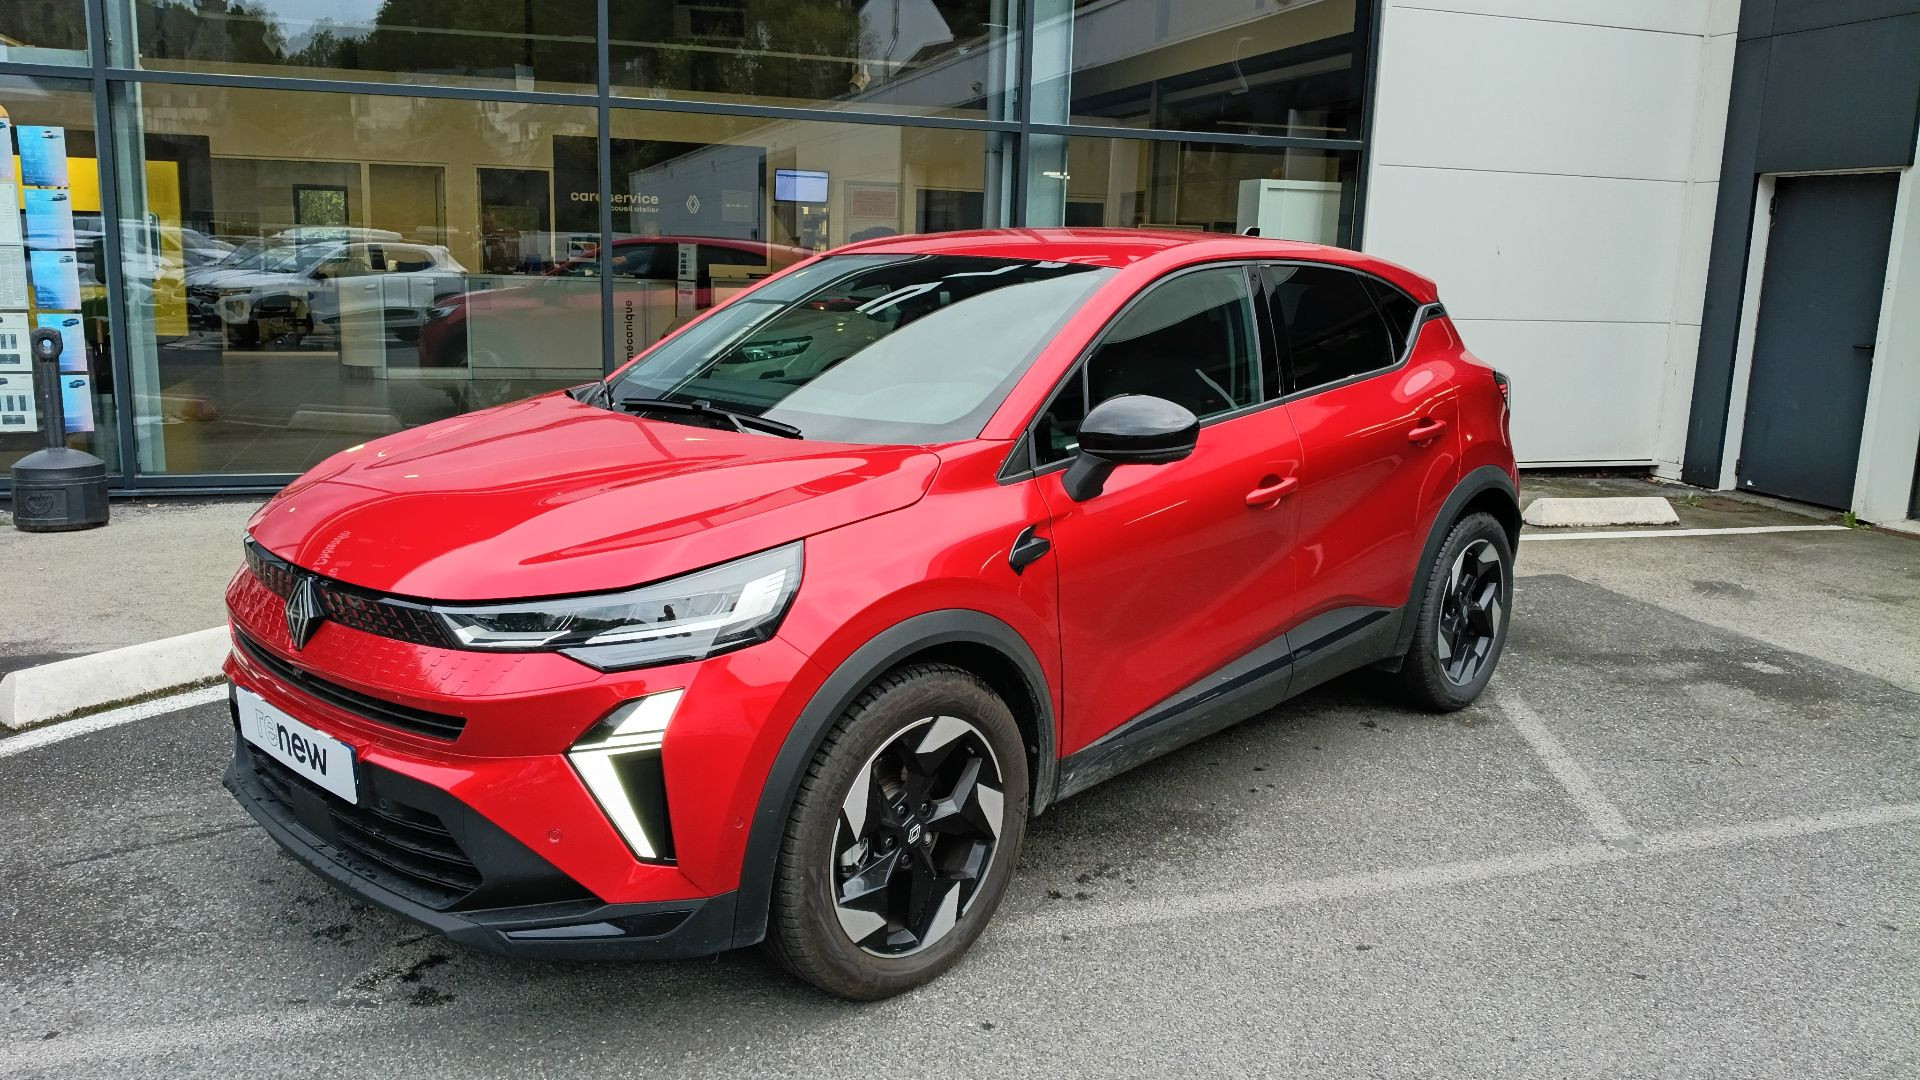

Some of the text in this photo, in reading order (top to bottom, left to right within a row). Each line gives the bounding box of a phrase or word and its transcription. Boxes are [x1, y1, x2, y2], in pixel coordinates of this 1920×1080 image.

[610, 193, 659, 205] service
[624, 299, 635, 362] mécanique
[255, 708, 328, 776] renew
